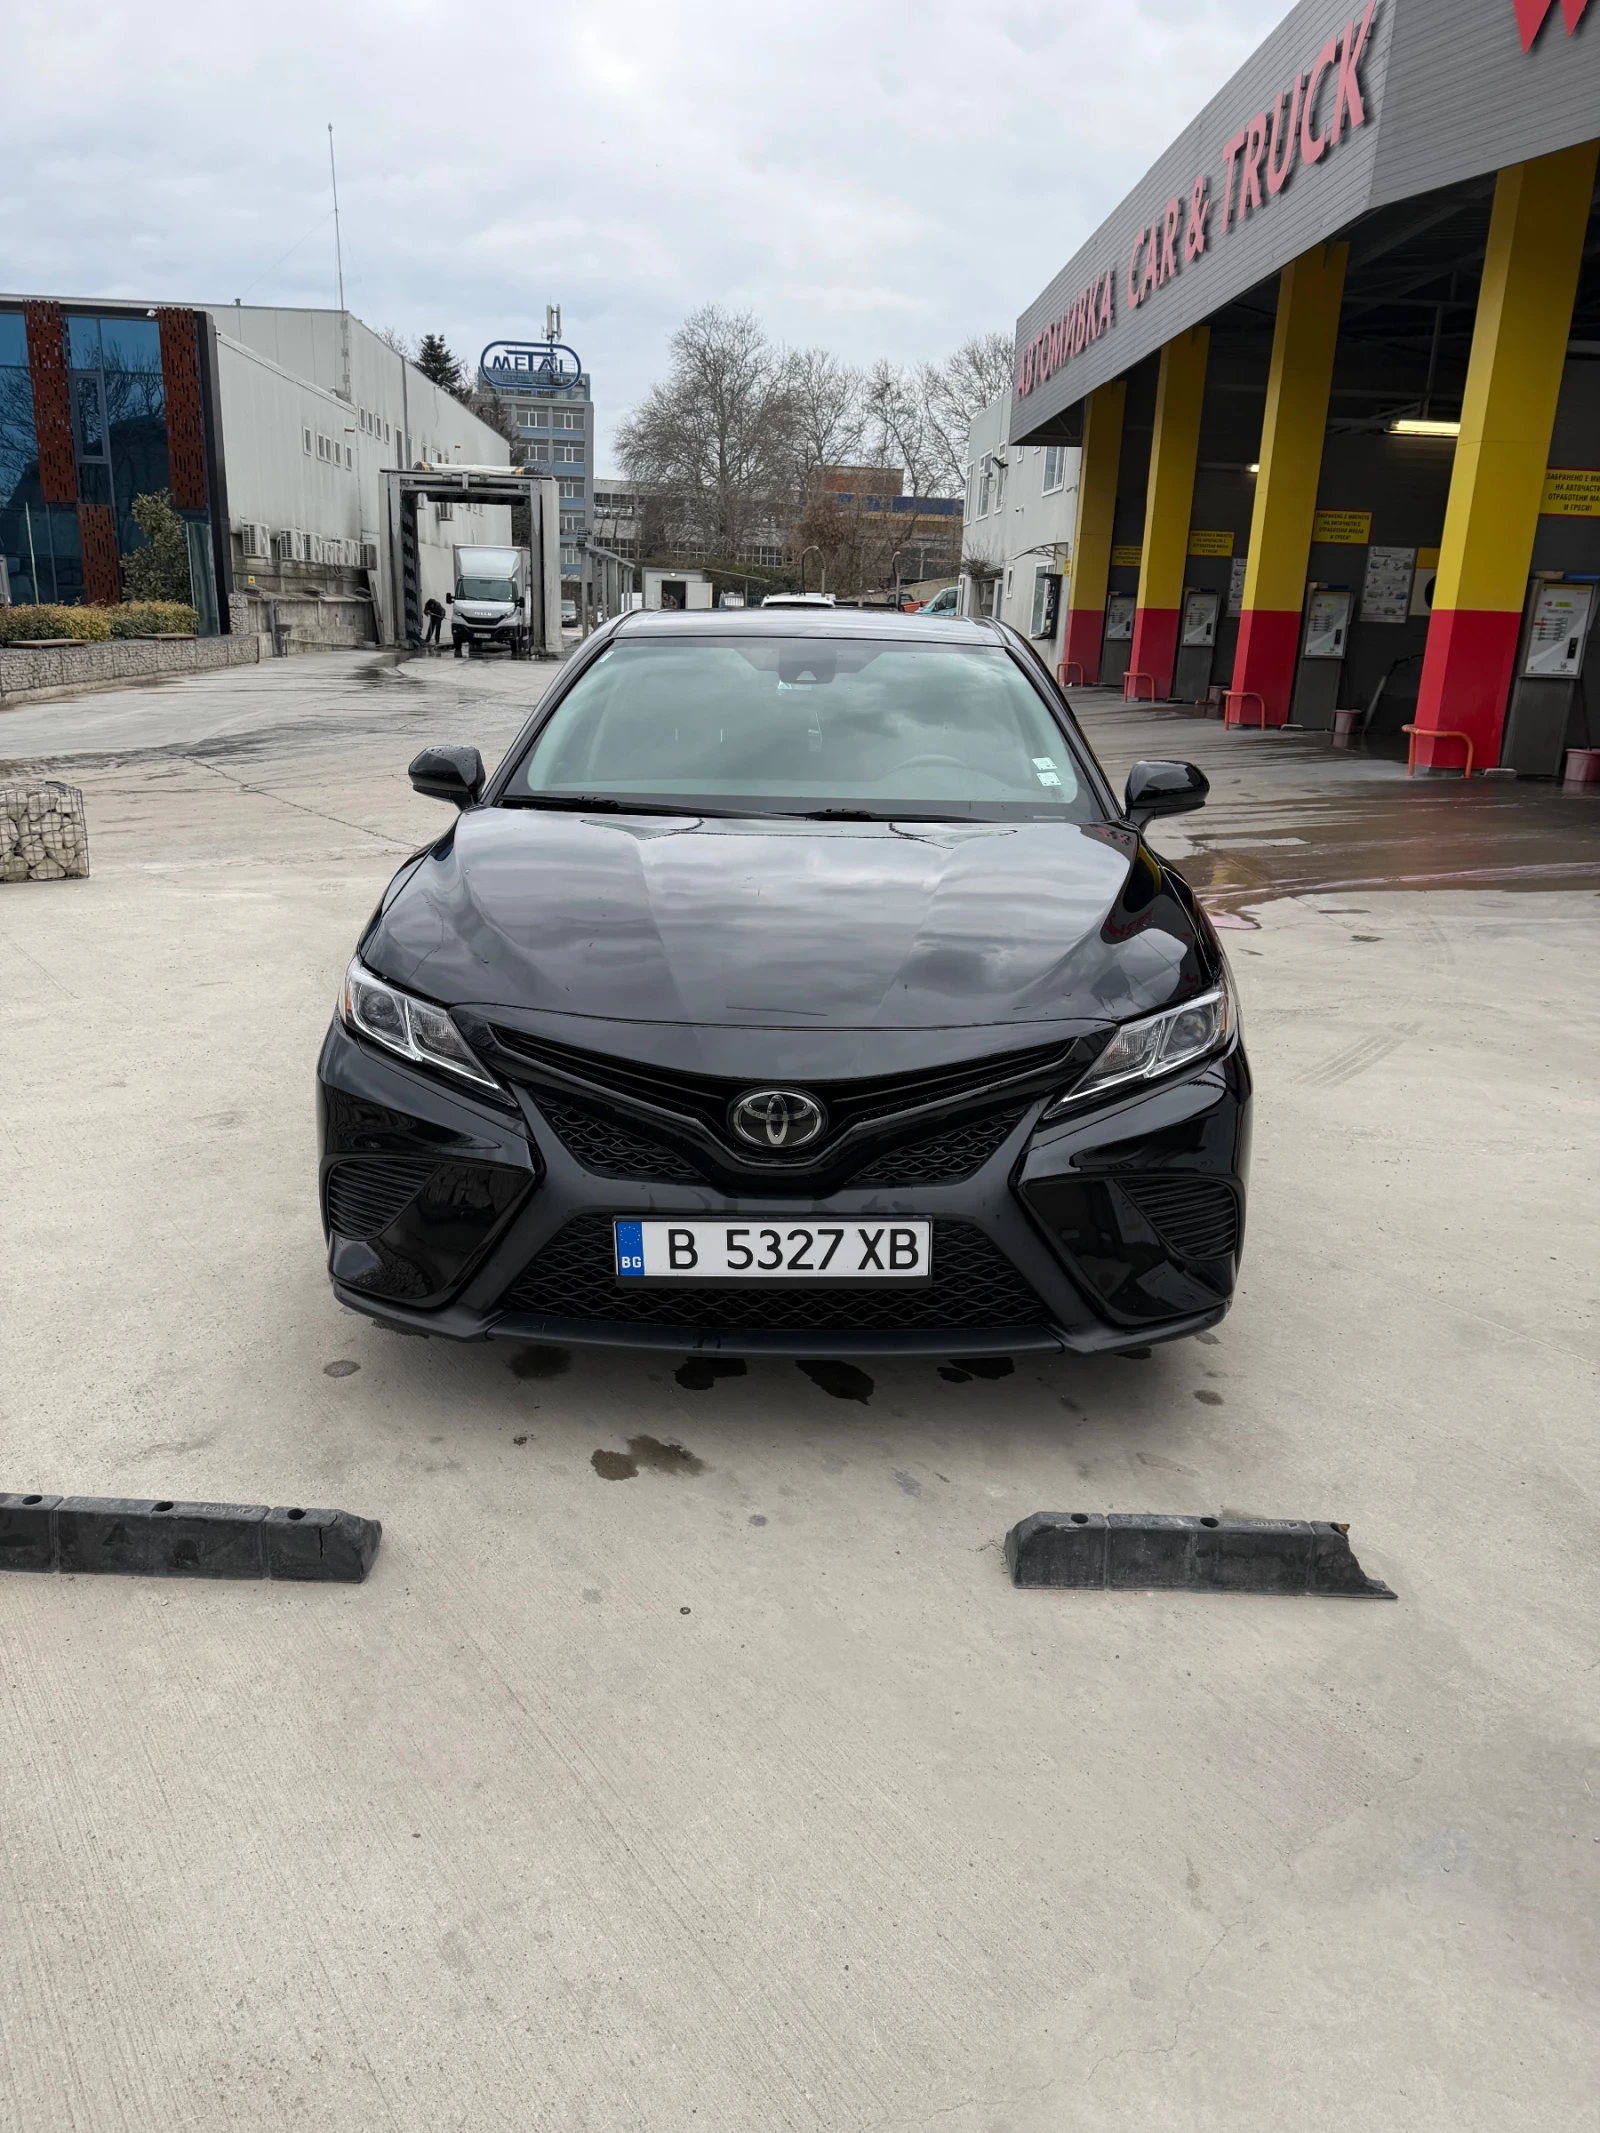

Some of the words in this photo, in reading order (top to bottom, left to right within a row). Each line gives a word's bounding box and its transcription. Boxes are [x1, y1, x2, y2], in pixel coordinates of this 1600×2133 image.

[1016, 264, 1112, 401] АВТОМИВКА
[1127, 197, 1180, 309] CAR
[1184, 173, 1210, 263] &
[1219, 0, 1377, 235] TRUCK
[621, 1256, 642, 1269] BG
[668, 1228, 698, 1270] B
[725, 1228, 844, 1270] 5327
